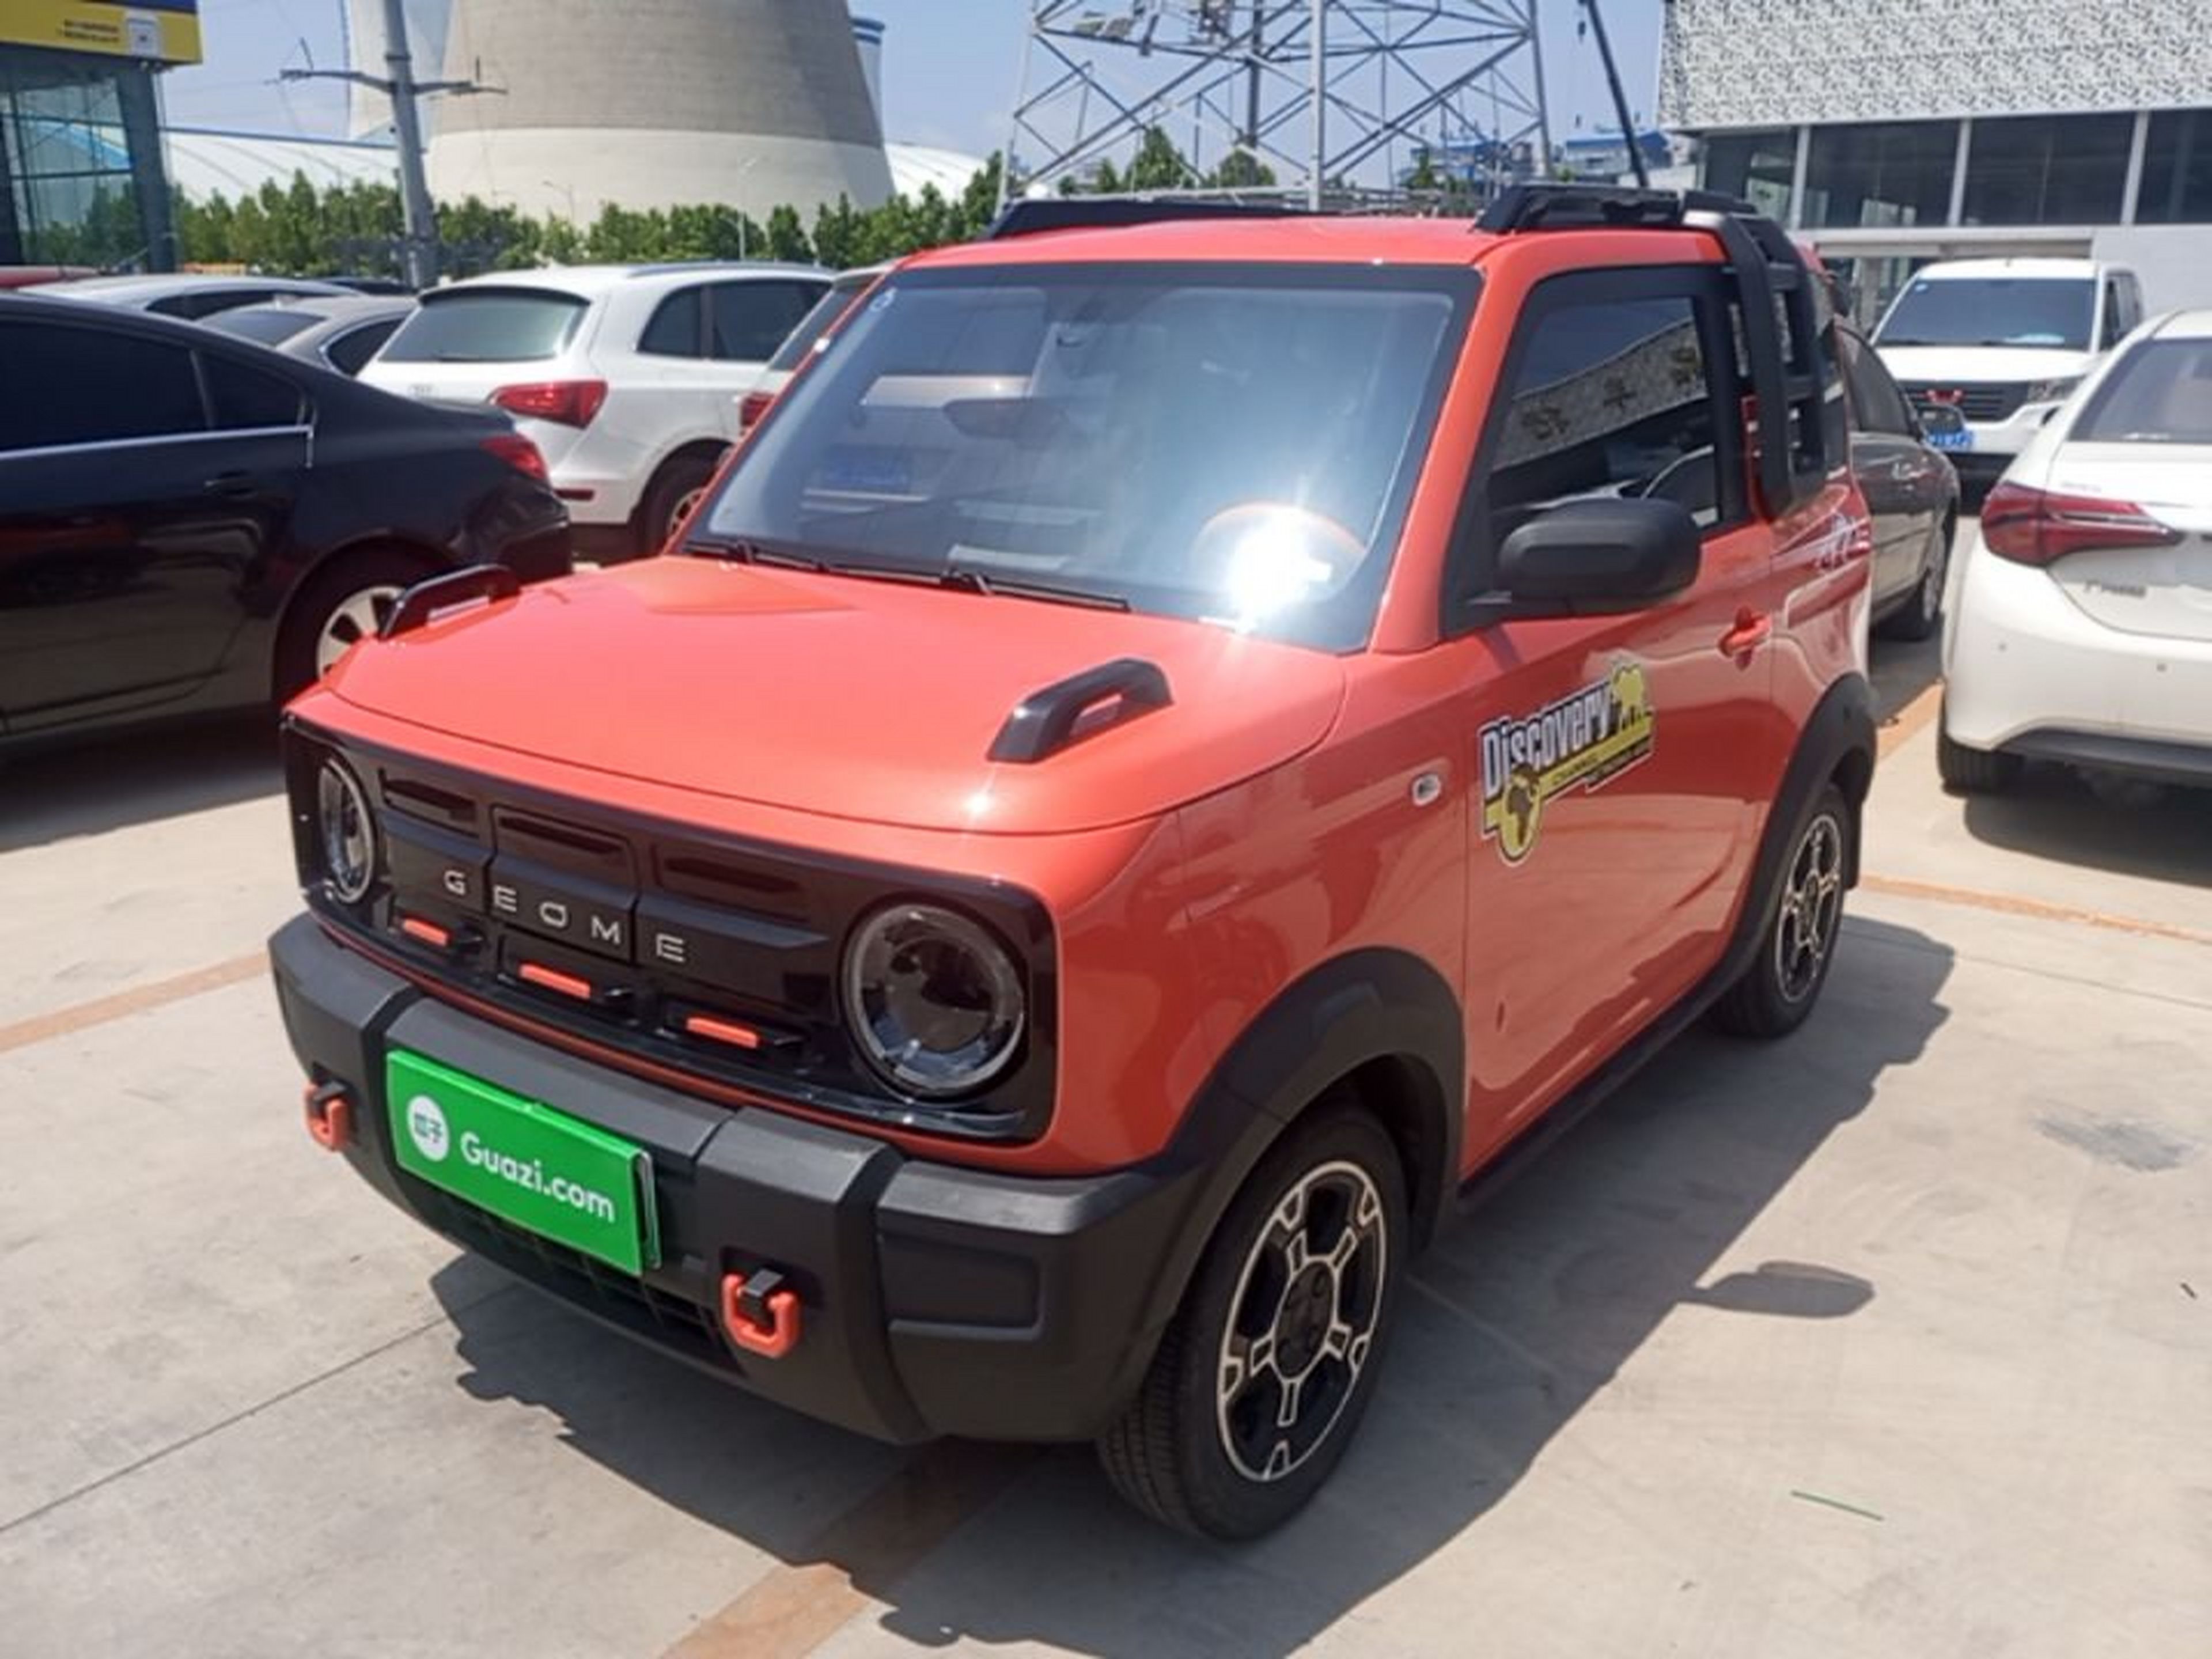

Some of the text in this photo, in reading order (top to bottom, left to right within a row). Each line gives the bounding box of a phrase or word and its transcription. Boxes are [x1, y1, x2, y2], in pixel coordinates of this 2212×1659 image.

[1482, 684, 1613, 800] Discovery
[444, 870, 685, 963] GEOME
[460, 1131, 615, 1223] Guazi.com
